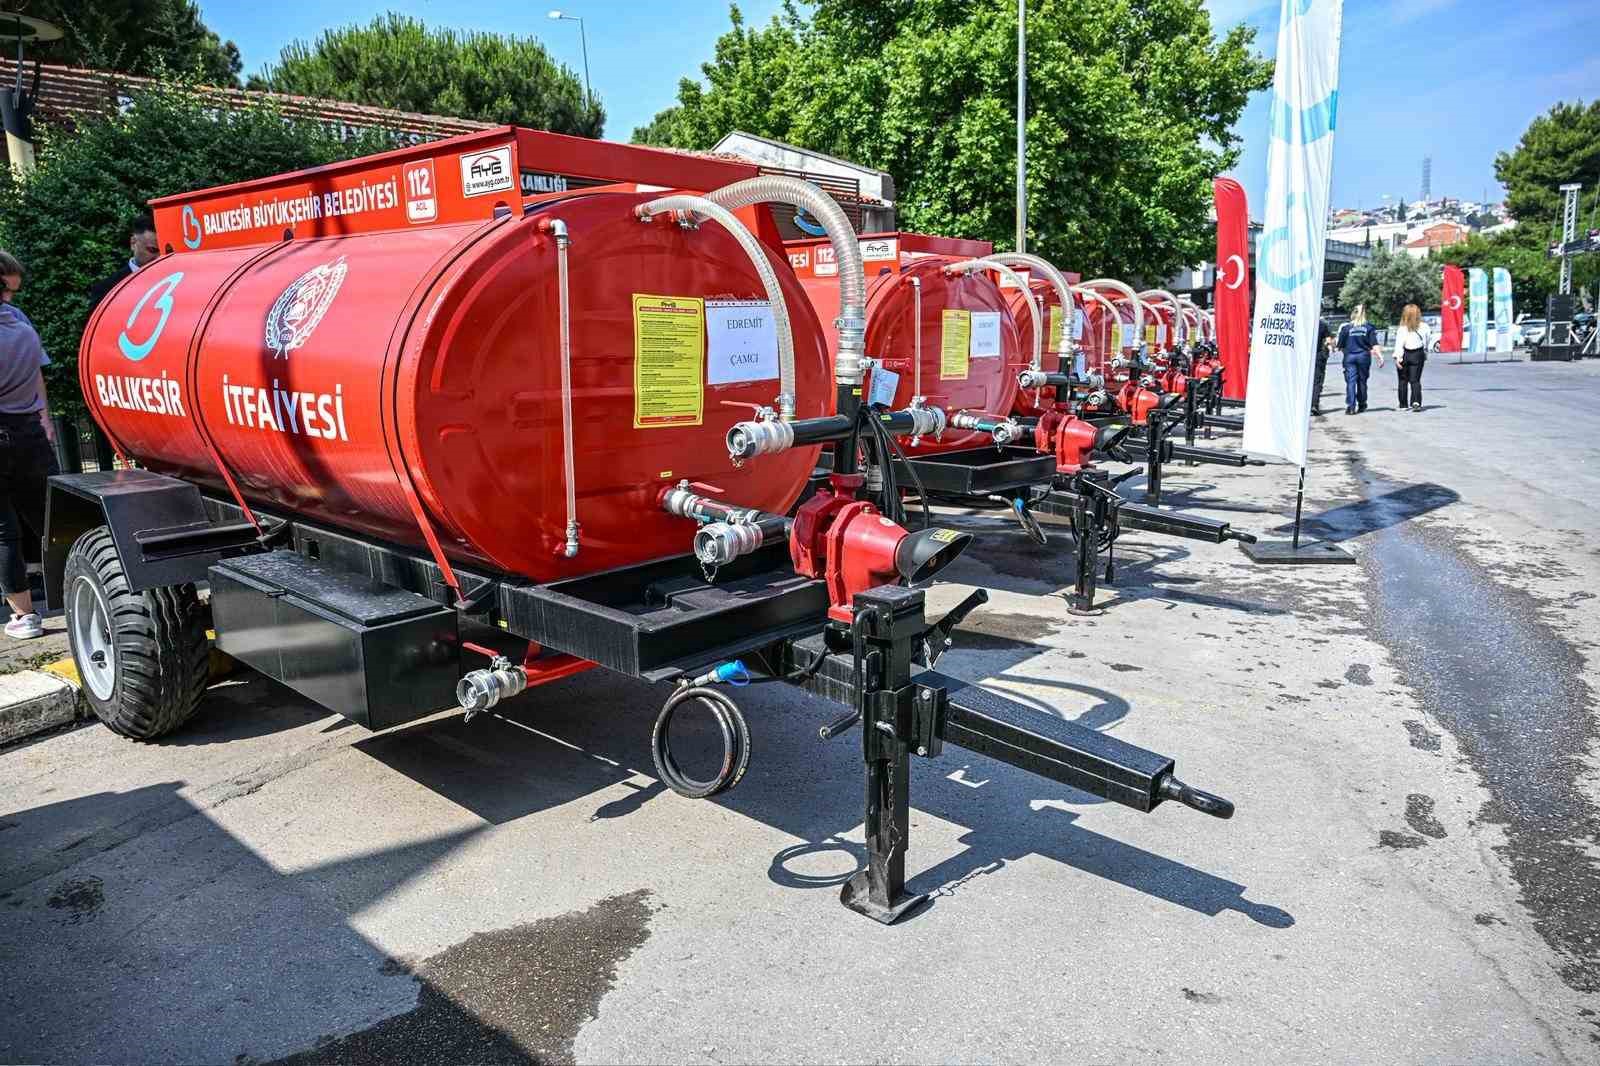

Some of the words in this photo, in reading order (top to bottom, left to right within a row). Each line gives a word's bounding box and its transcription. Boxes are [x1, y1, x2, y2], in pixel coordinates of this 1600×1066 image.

[408, 168, 431, 197] 112
[471, 161, 502, 178] AYG
[203, 203, 252, 235] BALIKESİR
[253, 190, 322, 227] BÜYÜKŞEHİR
[324, 175, 398, 217] BELEDİYESİ
[817, 247, 835, 263] 112
[95, 370, 187, 417] BALIKESİR
[222, 373, 349, 441] İTFAİYESİ
